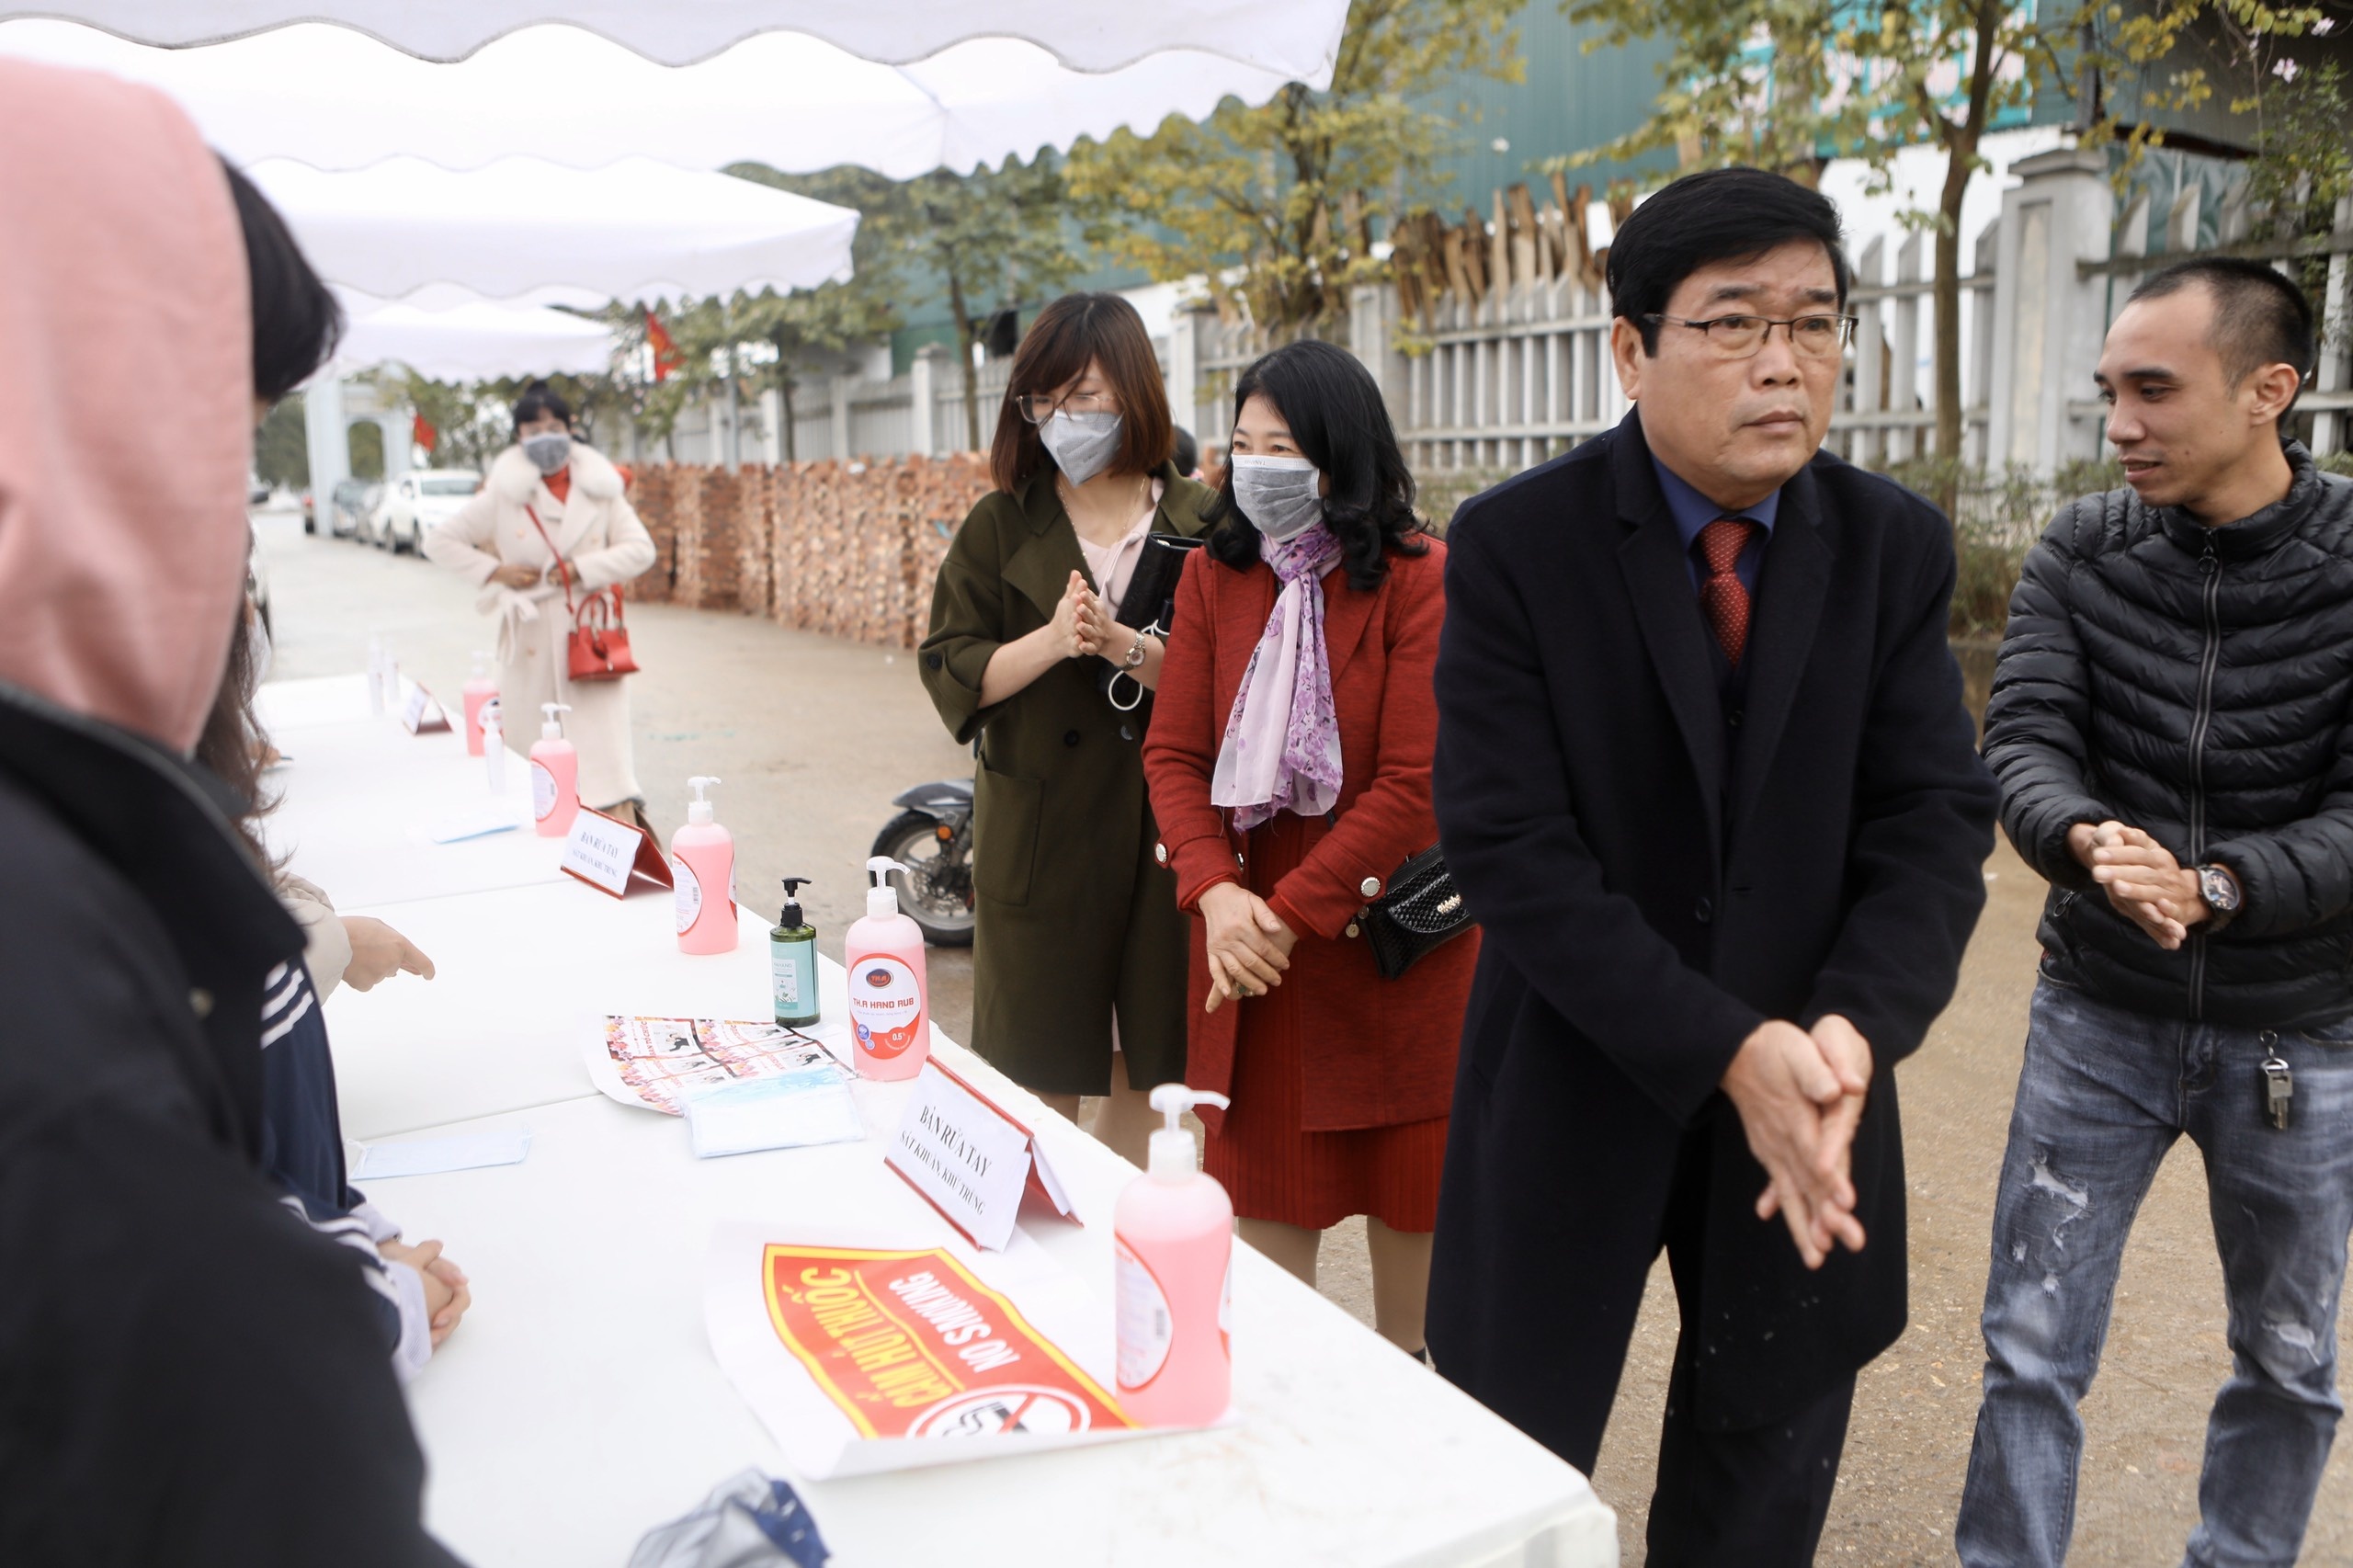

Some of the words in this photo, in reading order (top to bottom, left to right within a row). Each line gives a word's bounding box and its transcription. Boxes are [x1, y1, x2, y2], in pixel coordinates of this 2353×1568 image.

[870, 1000, 895, 1009] HAND
[897, 996, 915, 1008] RUB
[899, 1129, 916, 1151] SÁT
[965, 1144, 993, 1177] TAY
[781, 1267, 885, 1340] THUỐC
[888, 1270, 993, 1346] SMOKING
[830, 1324, 918, 1373] HÚT
[958, 1338, 1022, 1374] NO
[855, 1360, 954, 1408] CẤM
